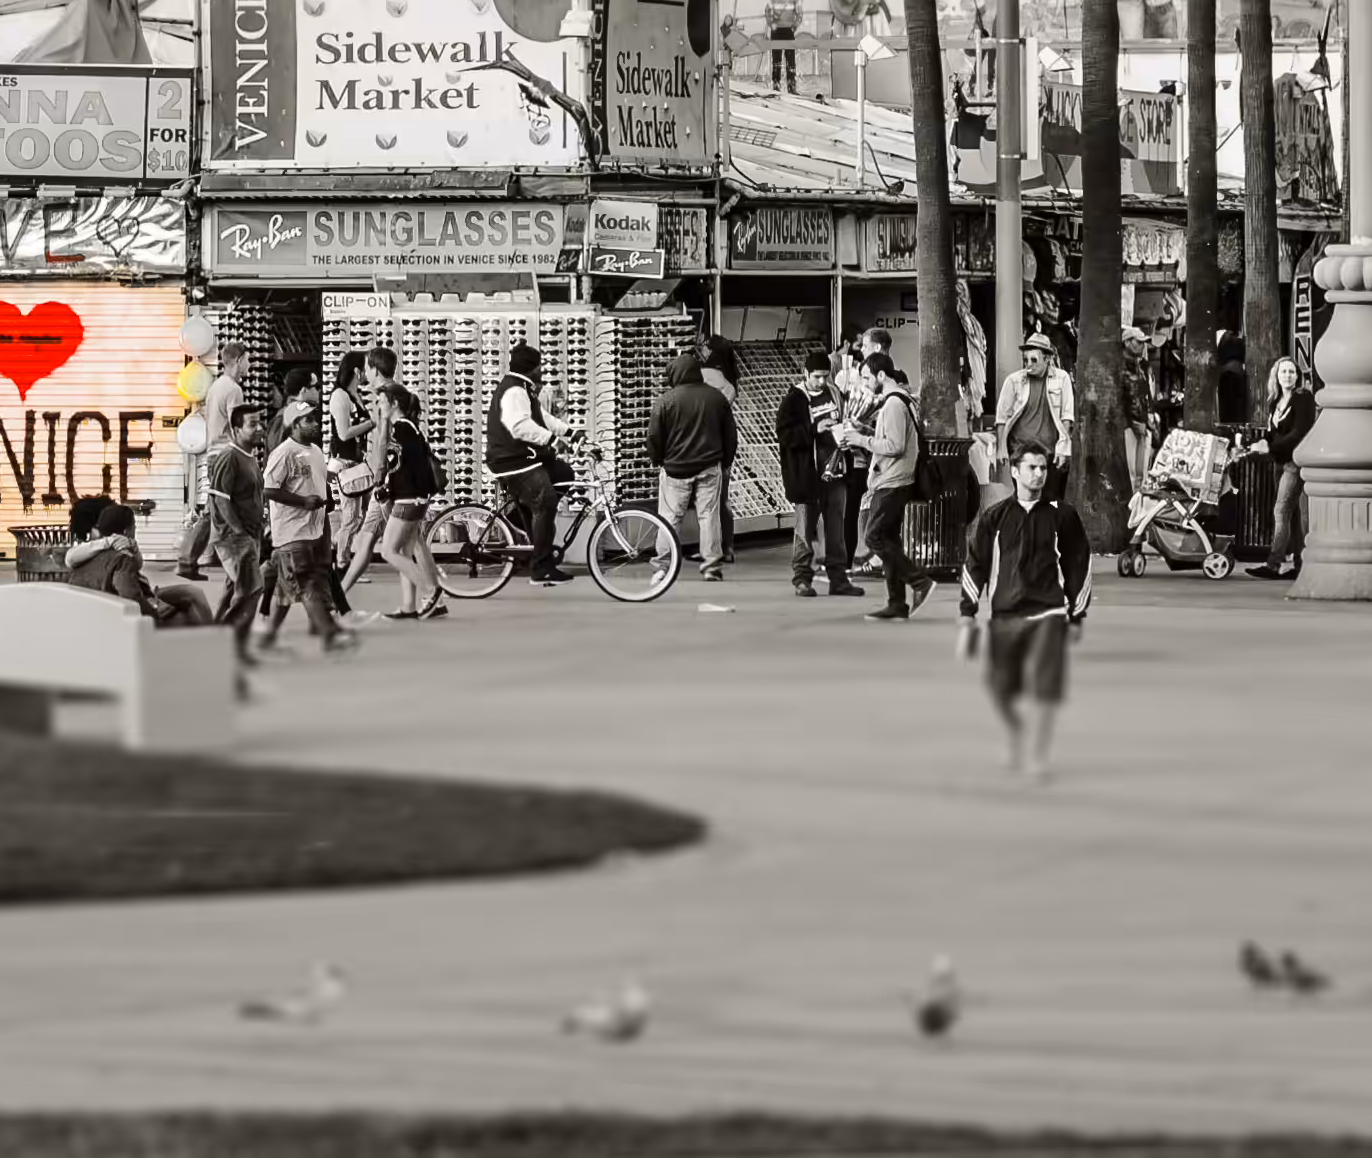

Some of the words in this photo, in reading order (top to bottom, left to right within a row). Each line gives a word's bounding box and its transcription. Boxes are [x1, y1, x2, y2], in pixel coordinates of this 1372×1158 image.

[314, 30, 520, 65] Sidewalk
[615, 50, 692, 99] Sidewalk
[156, 80, 183, 120] 2
[314, 79, 481, 111] Market
[149, 127, 188, 143] FOR
[616, 104, 678, 150] Market
[147, 148, 189, 173] $10
[313, 210, 556, 247] SUNGLASSES
[594, 213, 652, 231] Kodak
[757, 209, 832, 244] SUNGLASSES
[312, 255, 333, 265] THE
[335, 254, 380, 265] LARGEST
[383, 254, 441, 265] SELECTION
[443, 254, 455, 264] IN
[457, 254, 495, 264] VENICE
[498, 253, 529, 264] SINCE
[531, 253, 555, 264] 1982
[876, 317, 918, 329] CLIP-
